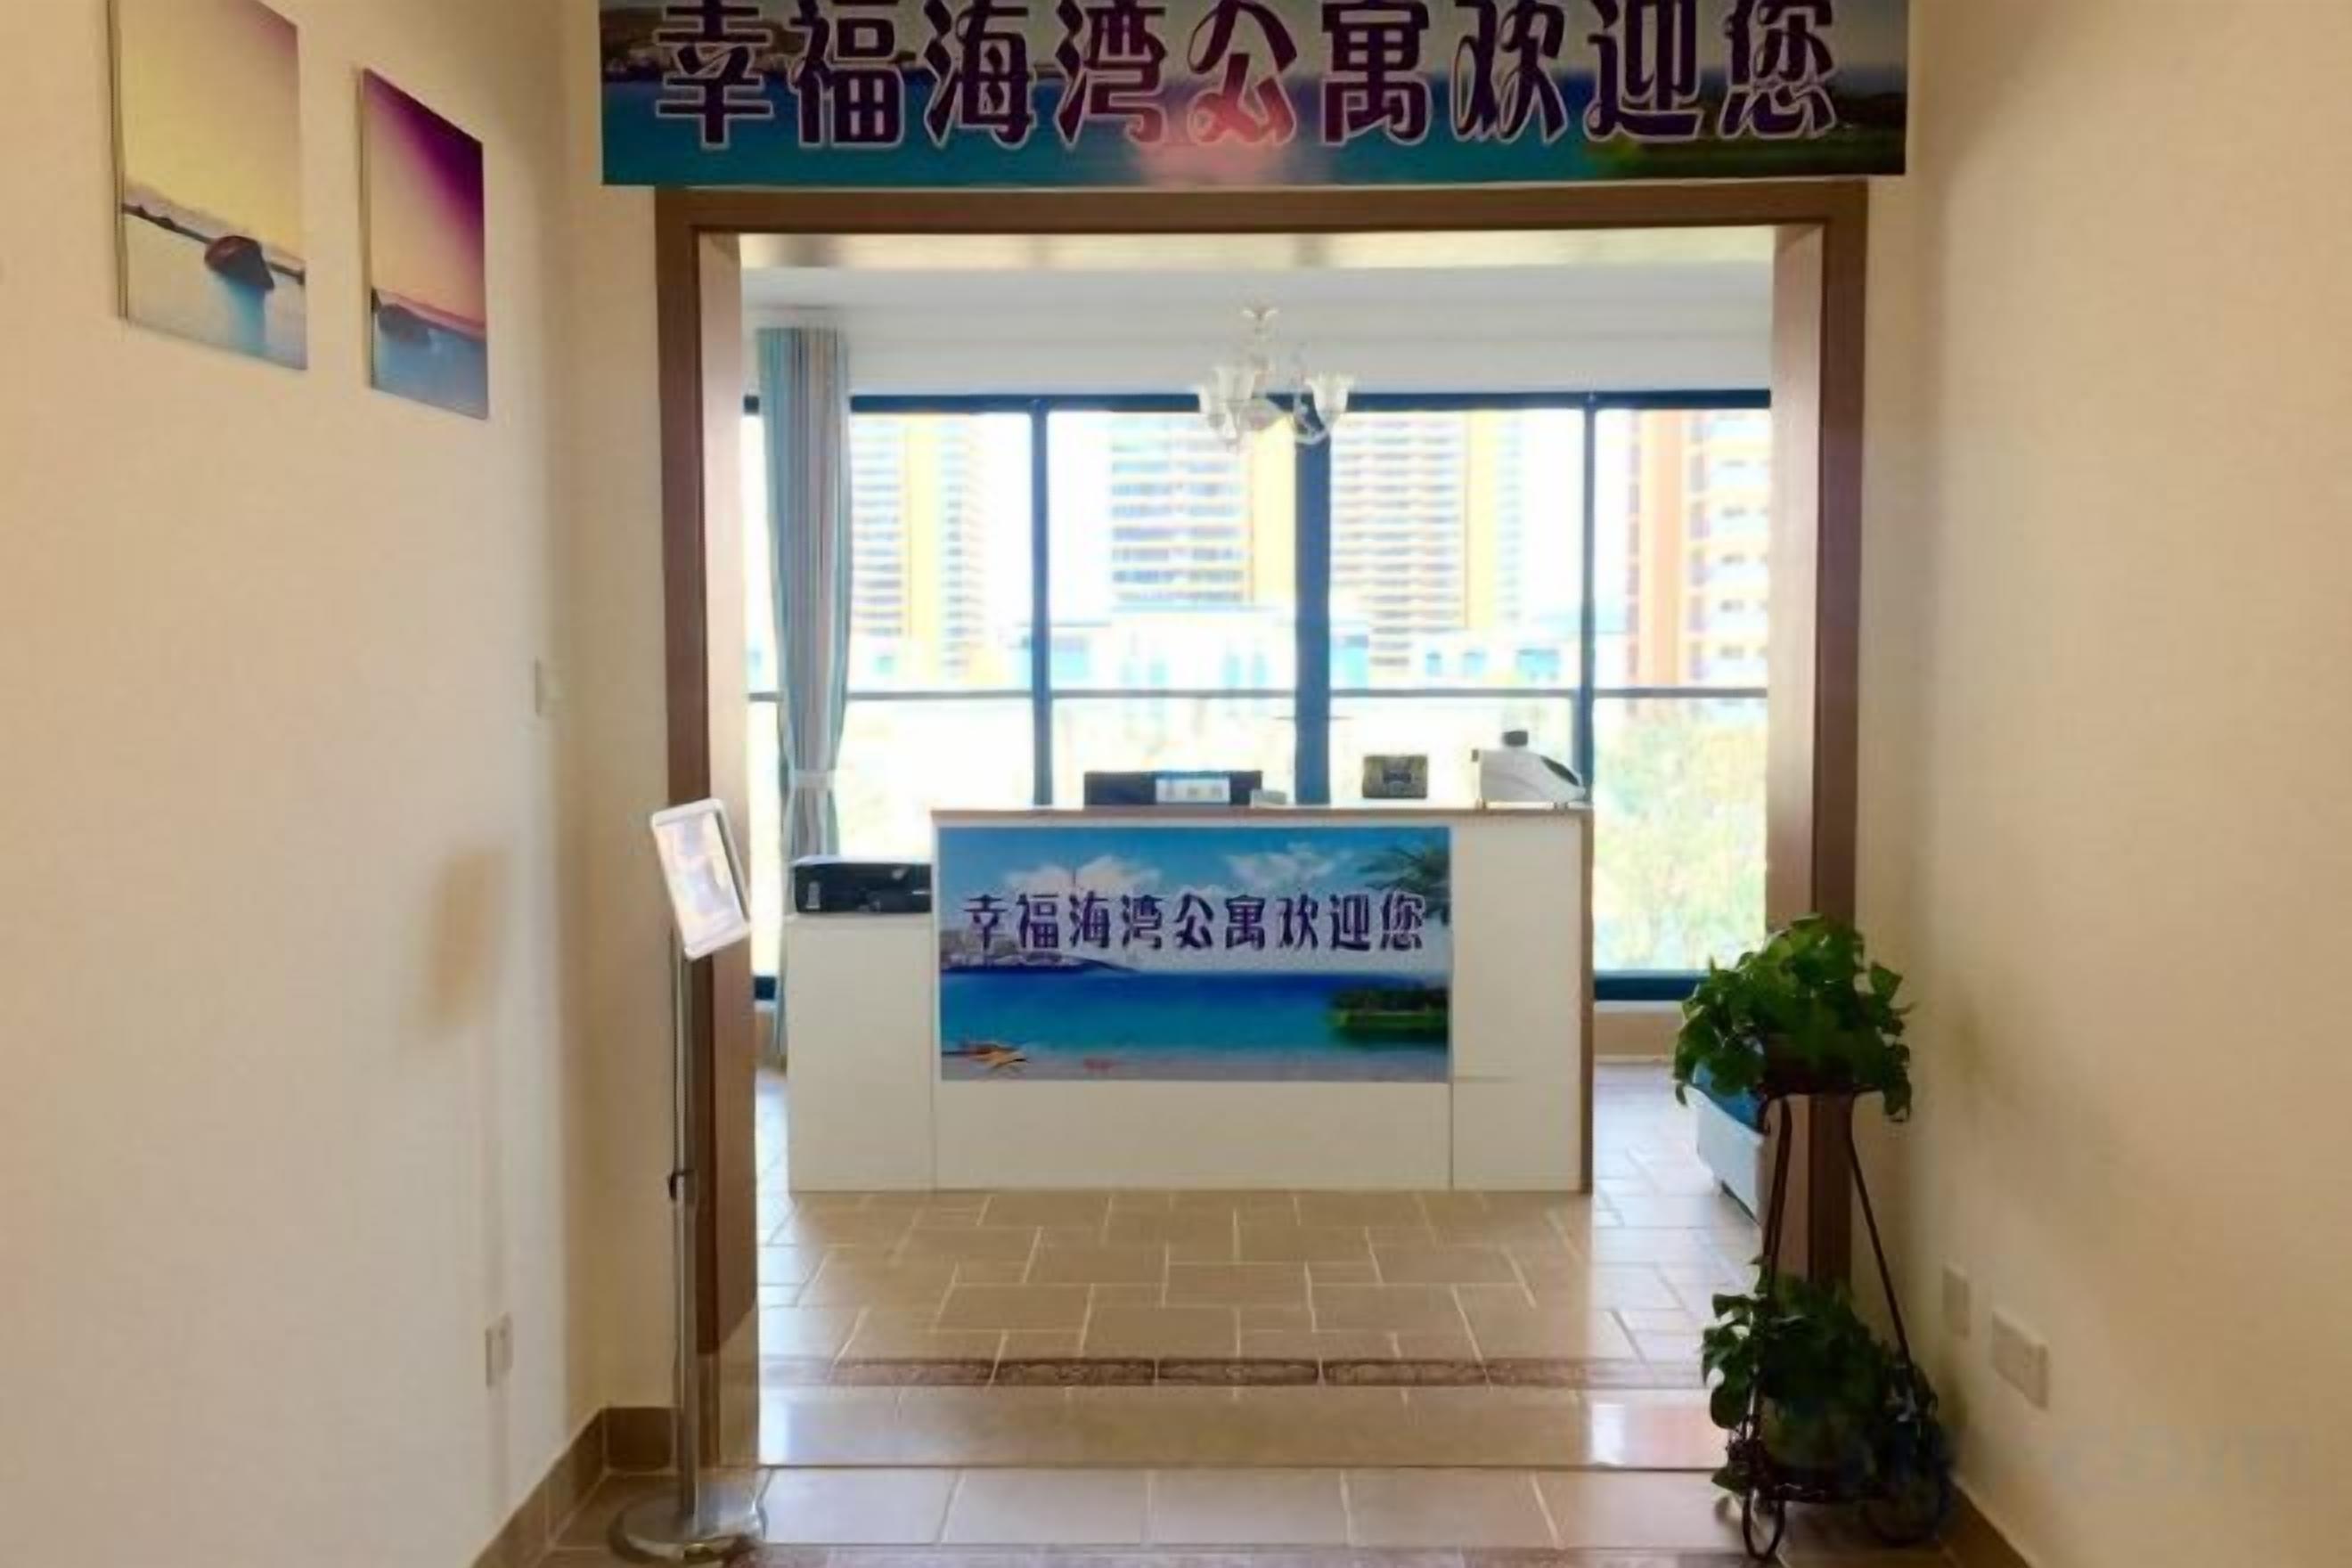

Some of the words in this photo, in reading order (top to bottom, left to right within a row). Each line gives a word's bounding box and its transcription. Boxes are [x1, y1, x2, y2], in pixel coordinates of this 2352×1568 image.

[655, 0, 1839, 149] 幸福海湾公寓欢迎您
[964, 891, 1425, 951] 幸福海湾公寓欢迎您
